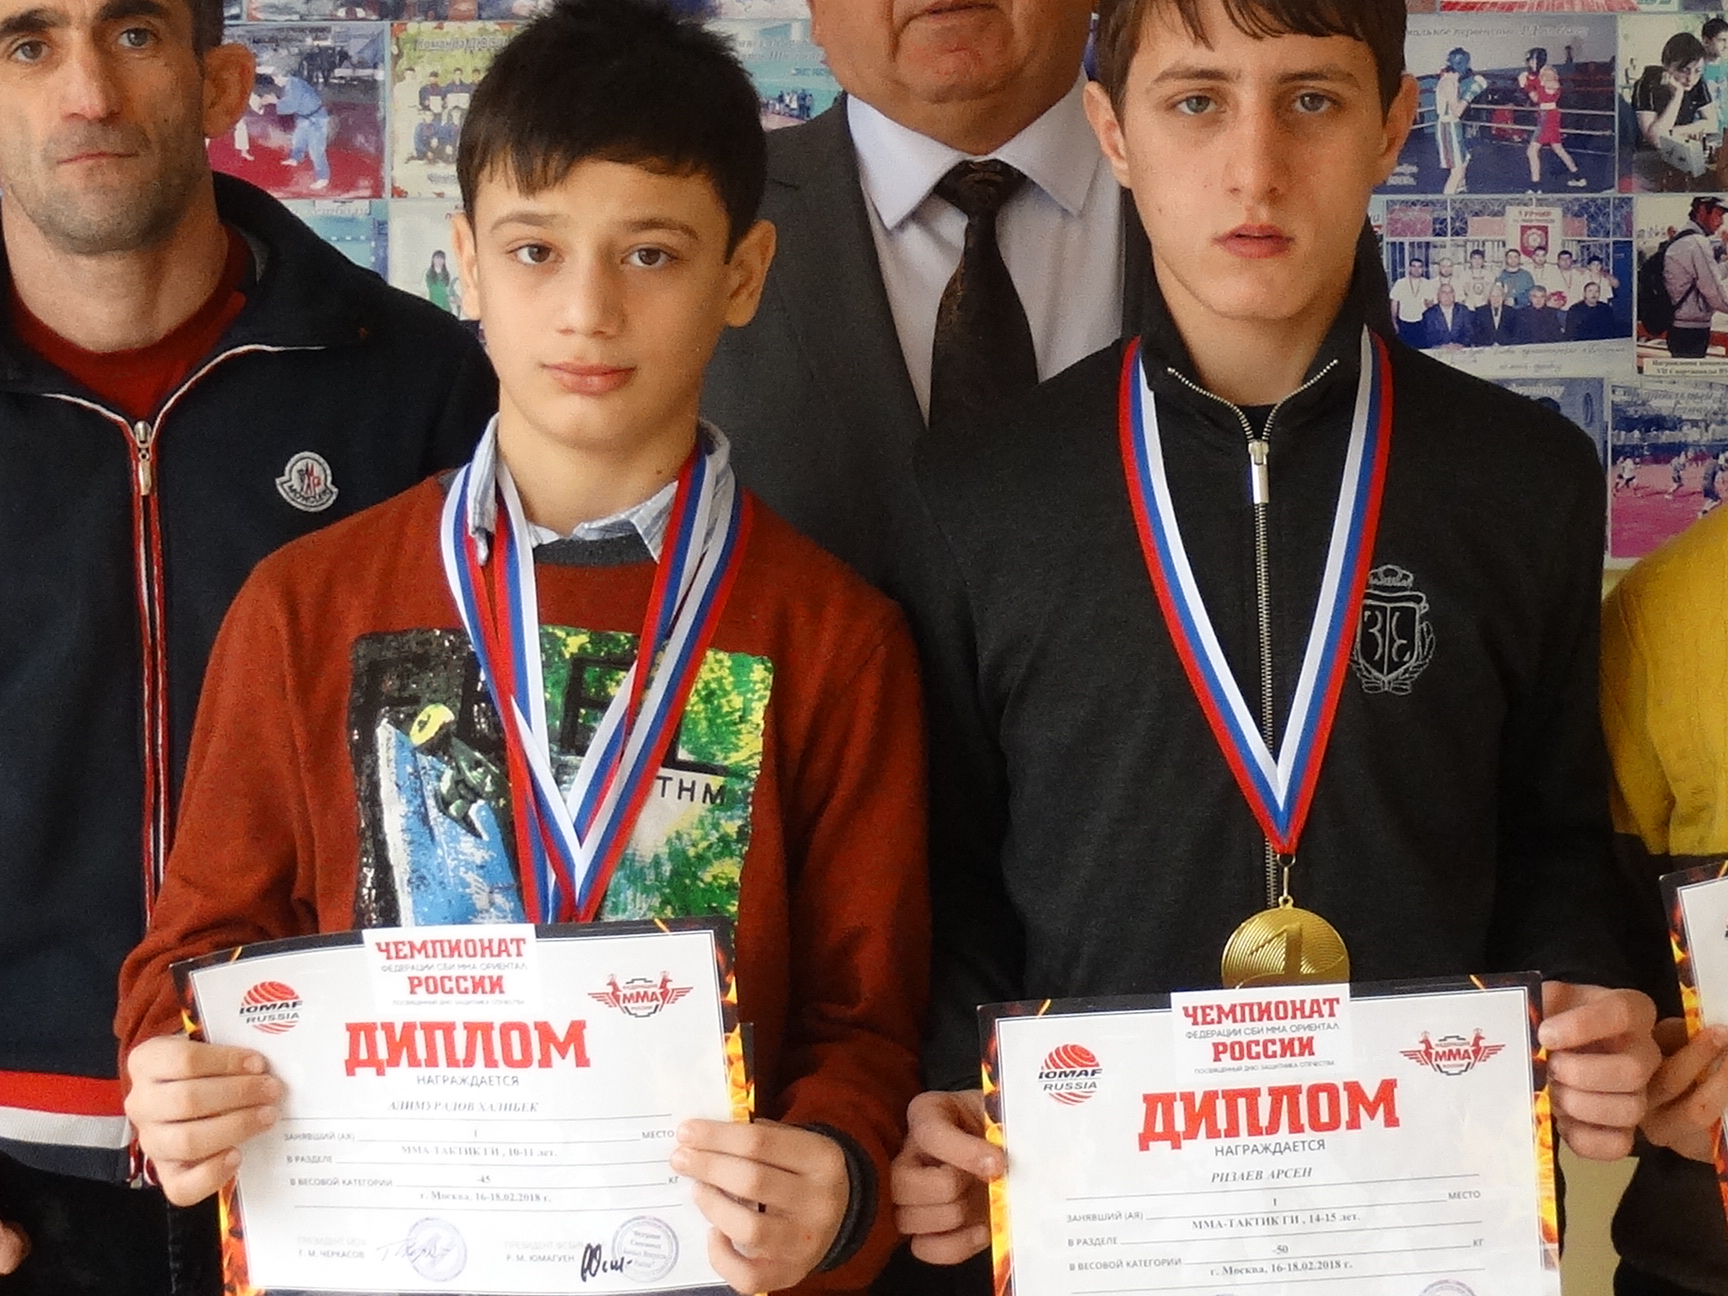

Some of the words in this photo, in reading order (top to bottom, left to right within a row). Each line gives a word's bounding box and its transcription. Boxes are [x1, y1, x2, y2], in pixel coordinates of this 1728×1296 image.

[375, 937, 526, 961] ЧЕМПИОНАТ
[380, 963, 434, 973] ФЕДЕРАЦИИ
[479, 962, 528, 971] ОРИЕНТАЛ
[407, 975, 505, 996] РОССИИ
[245, 1011, 300, 1024] RUSSIA
[1182, 997, 1340, 1027] ЧЕМПИОНАТ
[1185, 1026, 1242, 1040] ФЕДЕРАЦИИ
[1243, 1025, 1264, 1036] СБИ
[1266, 1024, 1288, 1035] ММА
[1289, 1021, 1340, 1033] ОРИЕНТАЛ
[344, 1020, 591, 1077] ДИПЛОМ
[1212, 1036, 1315, 1062] РОССИИ
[1433, 1047, 1472, 1063] ММА
[416, 1075, 520, 1088] НАГРАЖДАЕТСЯ
[1043, 1081, 1098, 1093] RUSSIA
[387, 1100, 476, 1113] АЛИМУРАДОВ
[477, 1101, 540, 1113] ХАЛИБЕК
[1138, 1078, 1400, 1152] ДИПЛОМ
[642, 1130, 675, 1140] МЕСТО
[1214, 1139, 1326, 1157] НАГРАЖДАЕТСЯ
[297, 1175, 340, 1187] ВЕСОВОЙ
[341, 1177, 393, 1187] КАТЕГОРИИ
[1211, 1169, 1264, 1184] РИЗАЕВ
[1267, 1167, 1313, 1181] АРСЕН
[1066, 1211, 1123, 1223] ЗАНЯВШИЙ
[1448, 1190, 1481, 1201] МЕСТО
[1309, 1212, 1337, 1224] 14-15
[1077, 1236, 1118, 1247] РАЗДЕЛЕ
[1077, 1259, 1123, 1270] ВЕСОВОЙ
[1125, 1257, 1182, 1269] КАТЕГОРИИ
[1270, 1260, 1340, 1275] 16-18.02.2018
